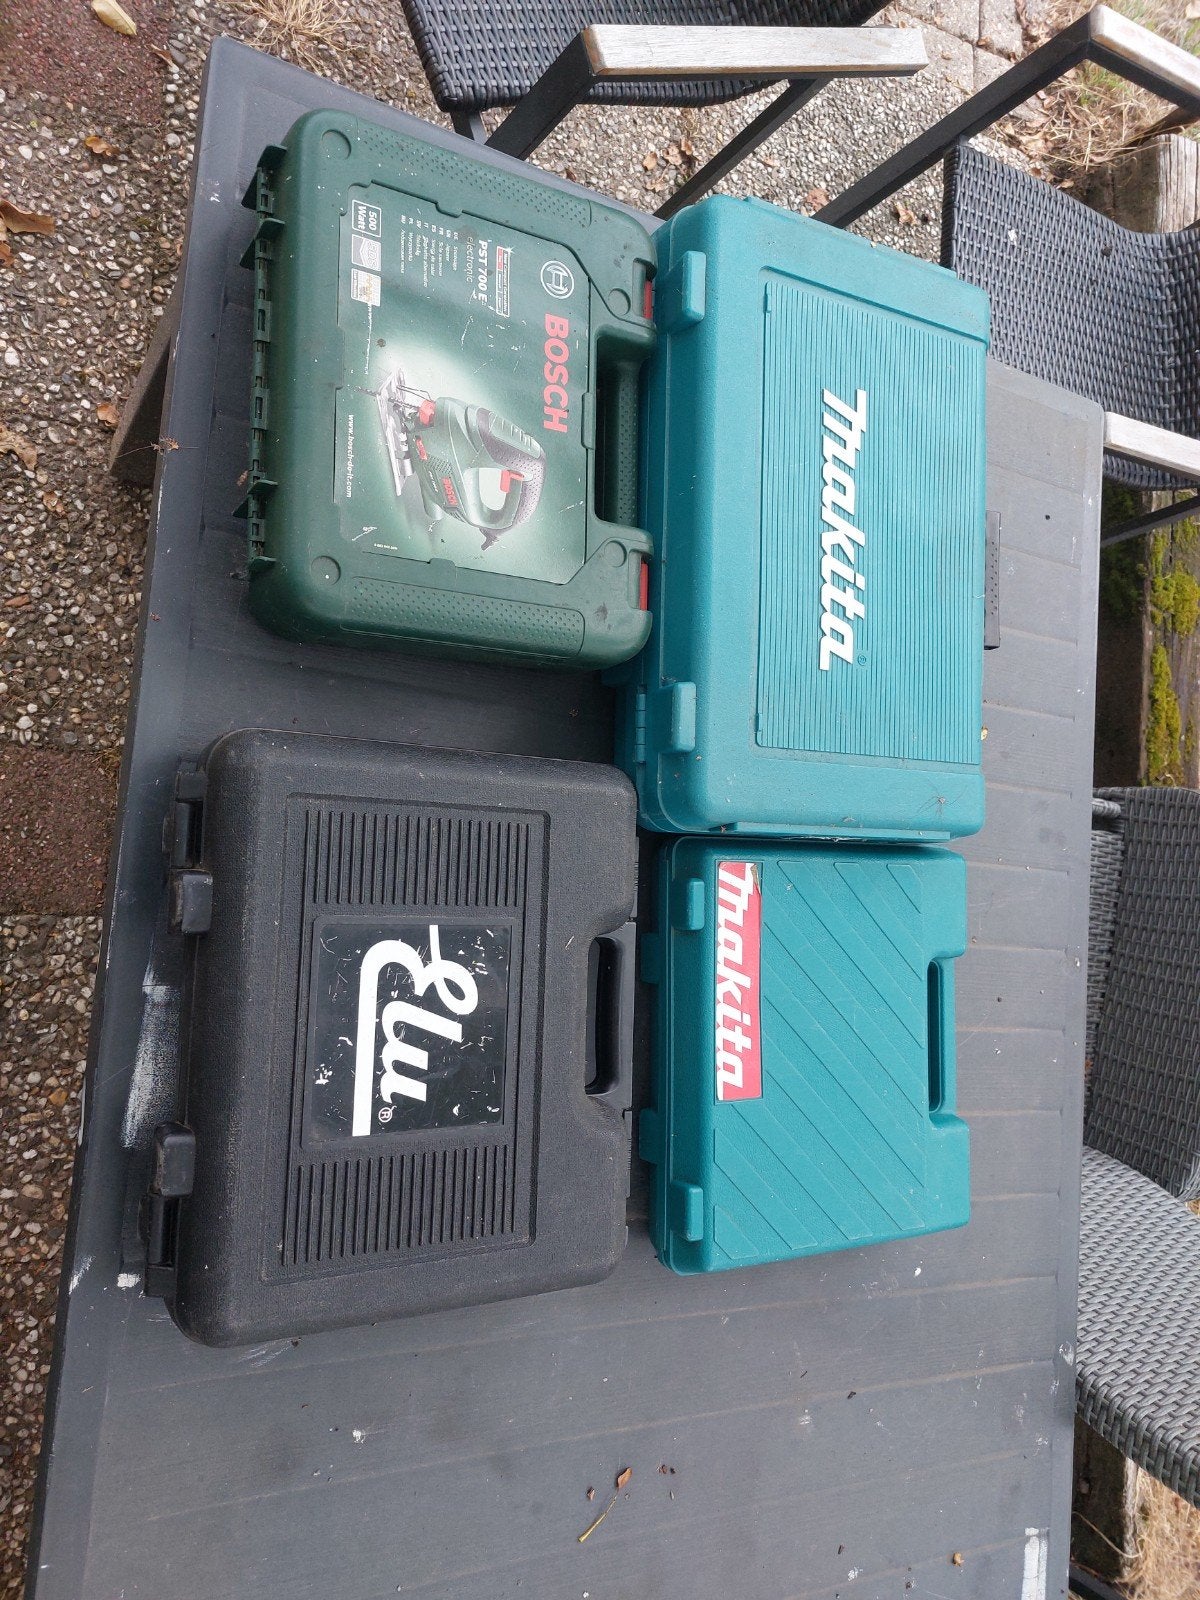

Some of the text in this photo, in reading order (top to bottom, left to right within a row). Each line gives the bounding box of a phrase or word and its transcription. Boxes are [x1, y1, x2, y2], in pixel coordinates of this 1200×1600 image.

[358, 205, 366, 230] Watt
[369, 211, 377, 230] 500
[466, 237, 475, 282] electronic
[478, 239, 488, 302] PST 700 E
[543, 312, 570, 433] BOSCH
[346, 414, 354, 498] www.bosch-do-it.com
[442, 477, 458, 505] BOSCH
[352, 925, 479, 1137] Elu
